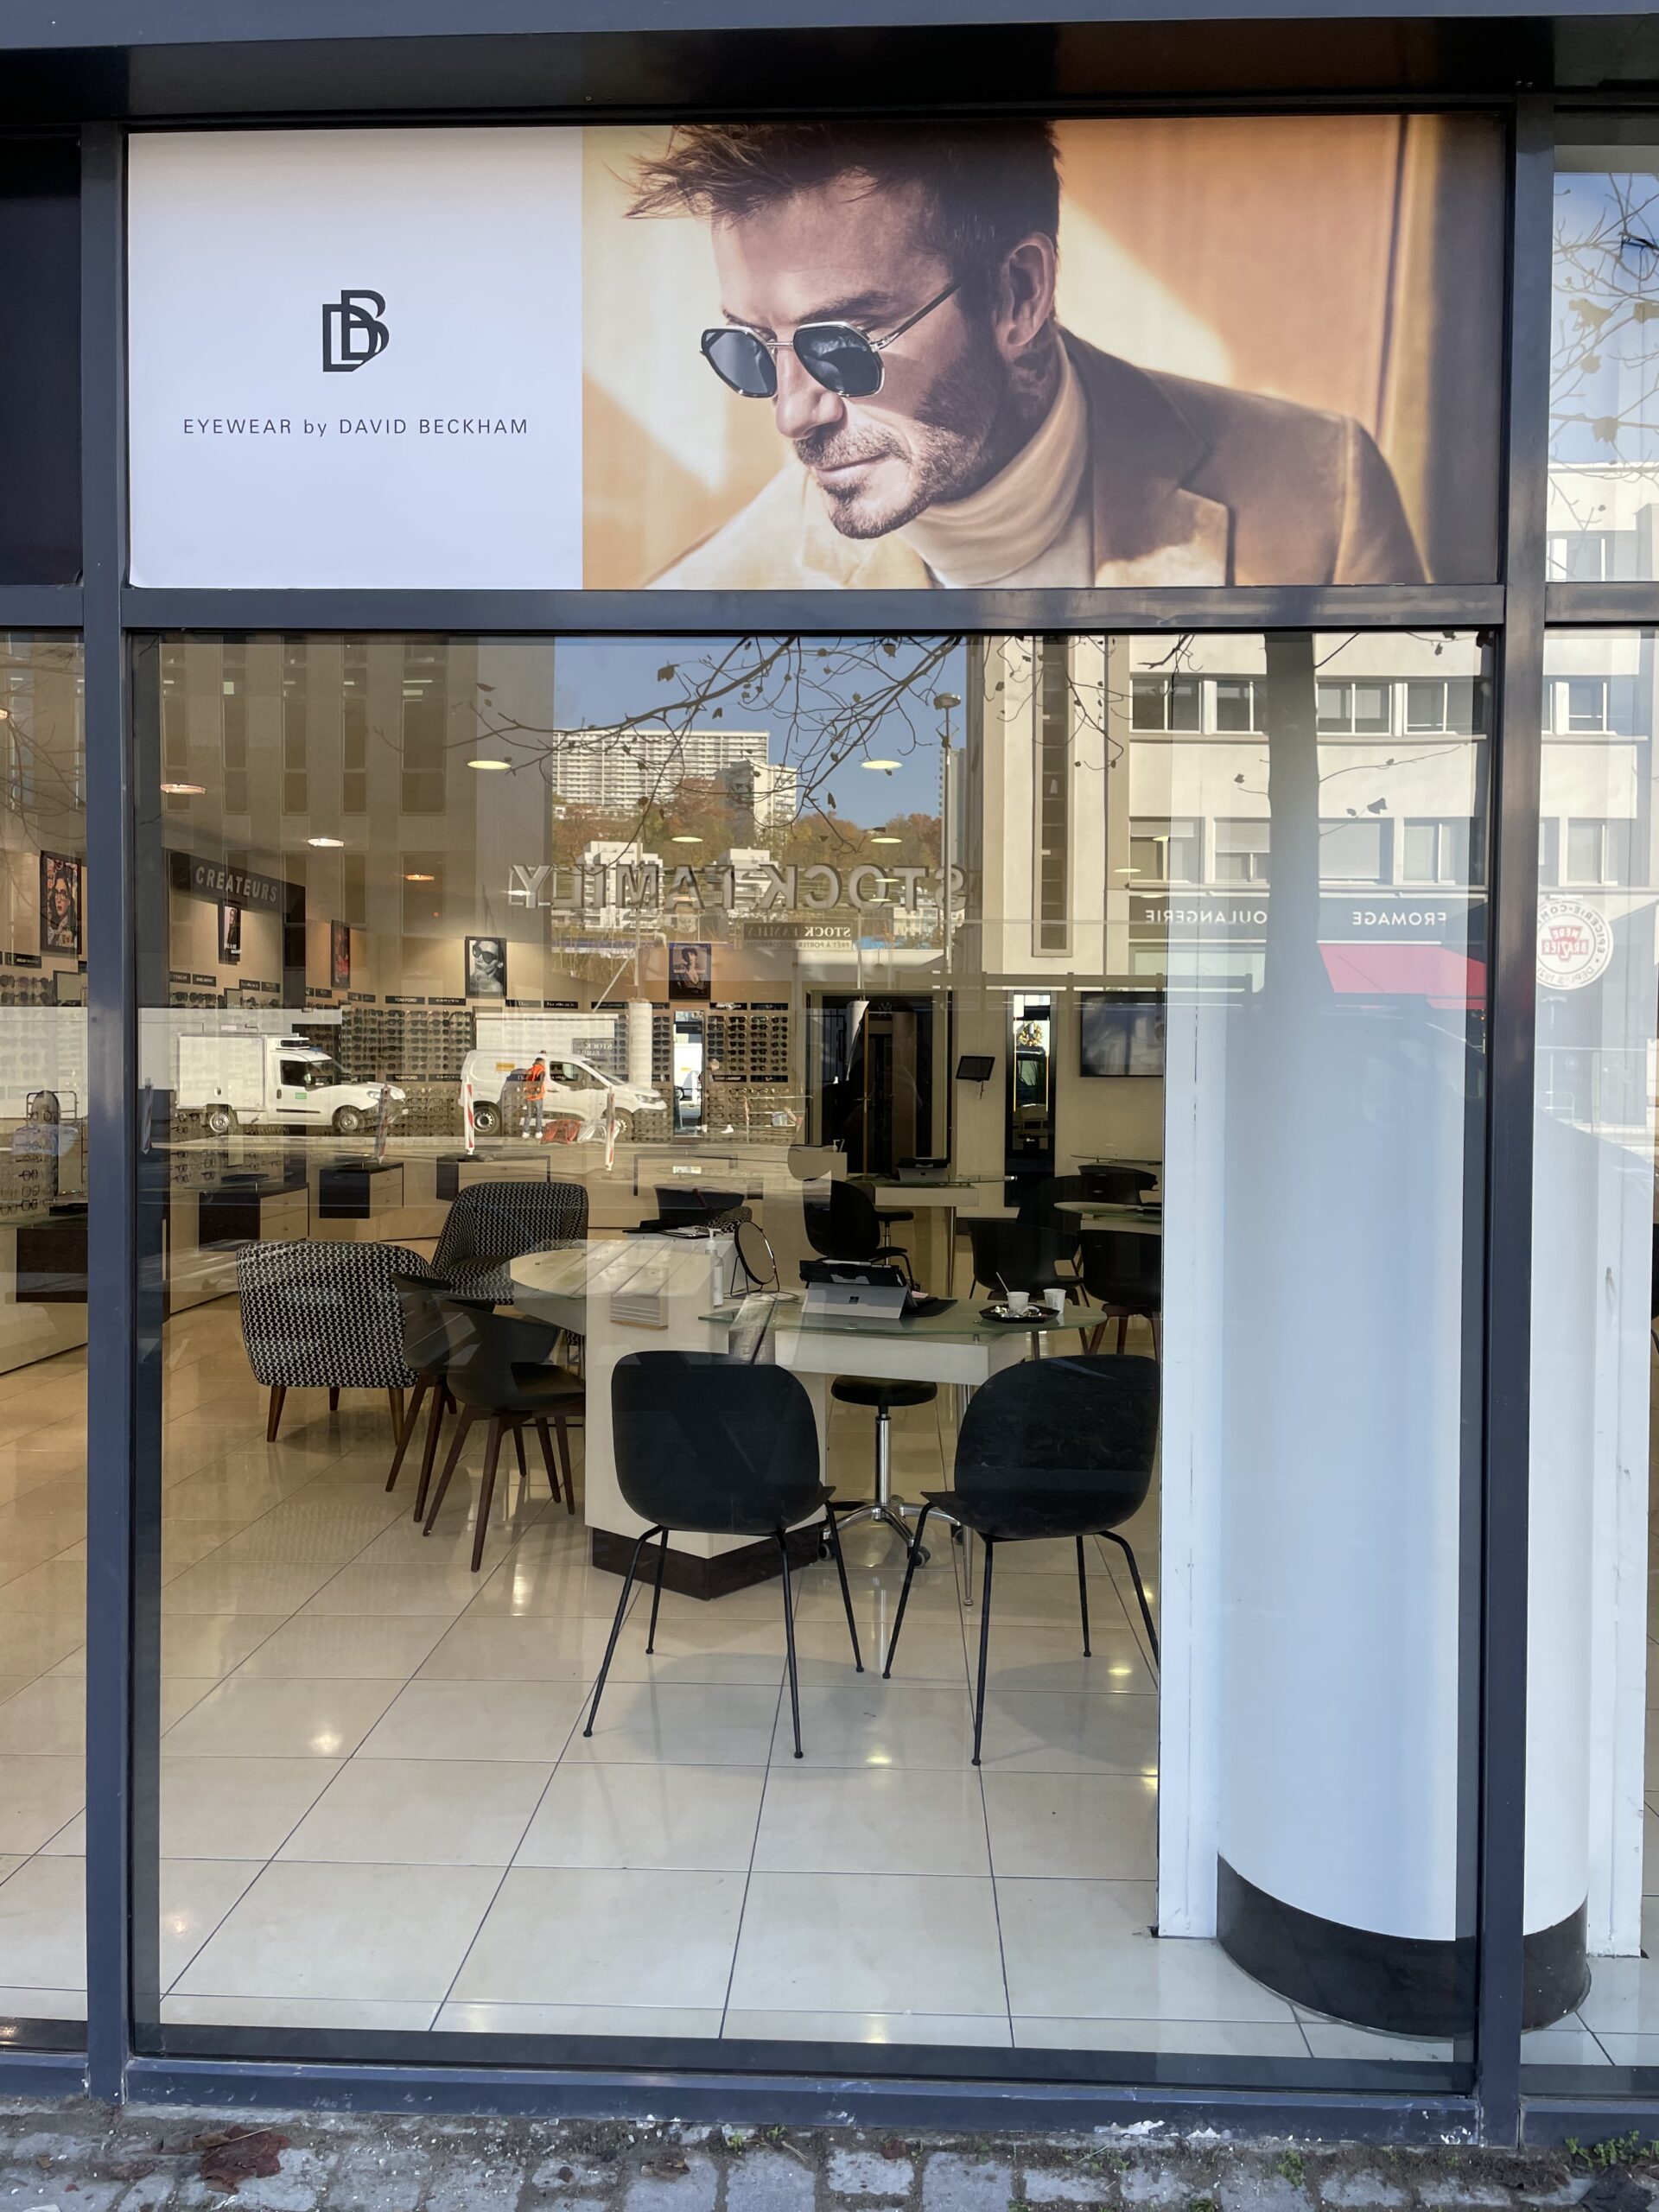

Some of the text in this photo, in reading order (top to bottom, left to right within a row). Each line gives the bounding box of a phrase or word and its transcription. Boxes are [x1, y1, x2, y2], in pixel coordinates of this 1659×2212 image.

[183, 419, 529, 437] EYEWEAR by DAVID BECKHAM
[195, 866, 277, 903] CREATEURS
